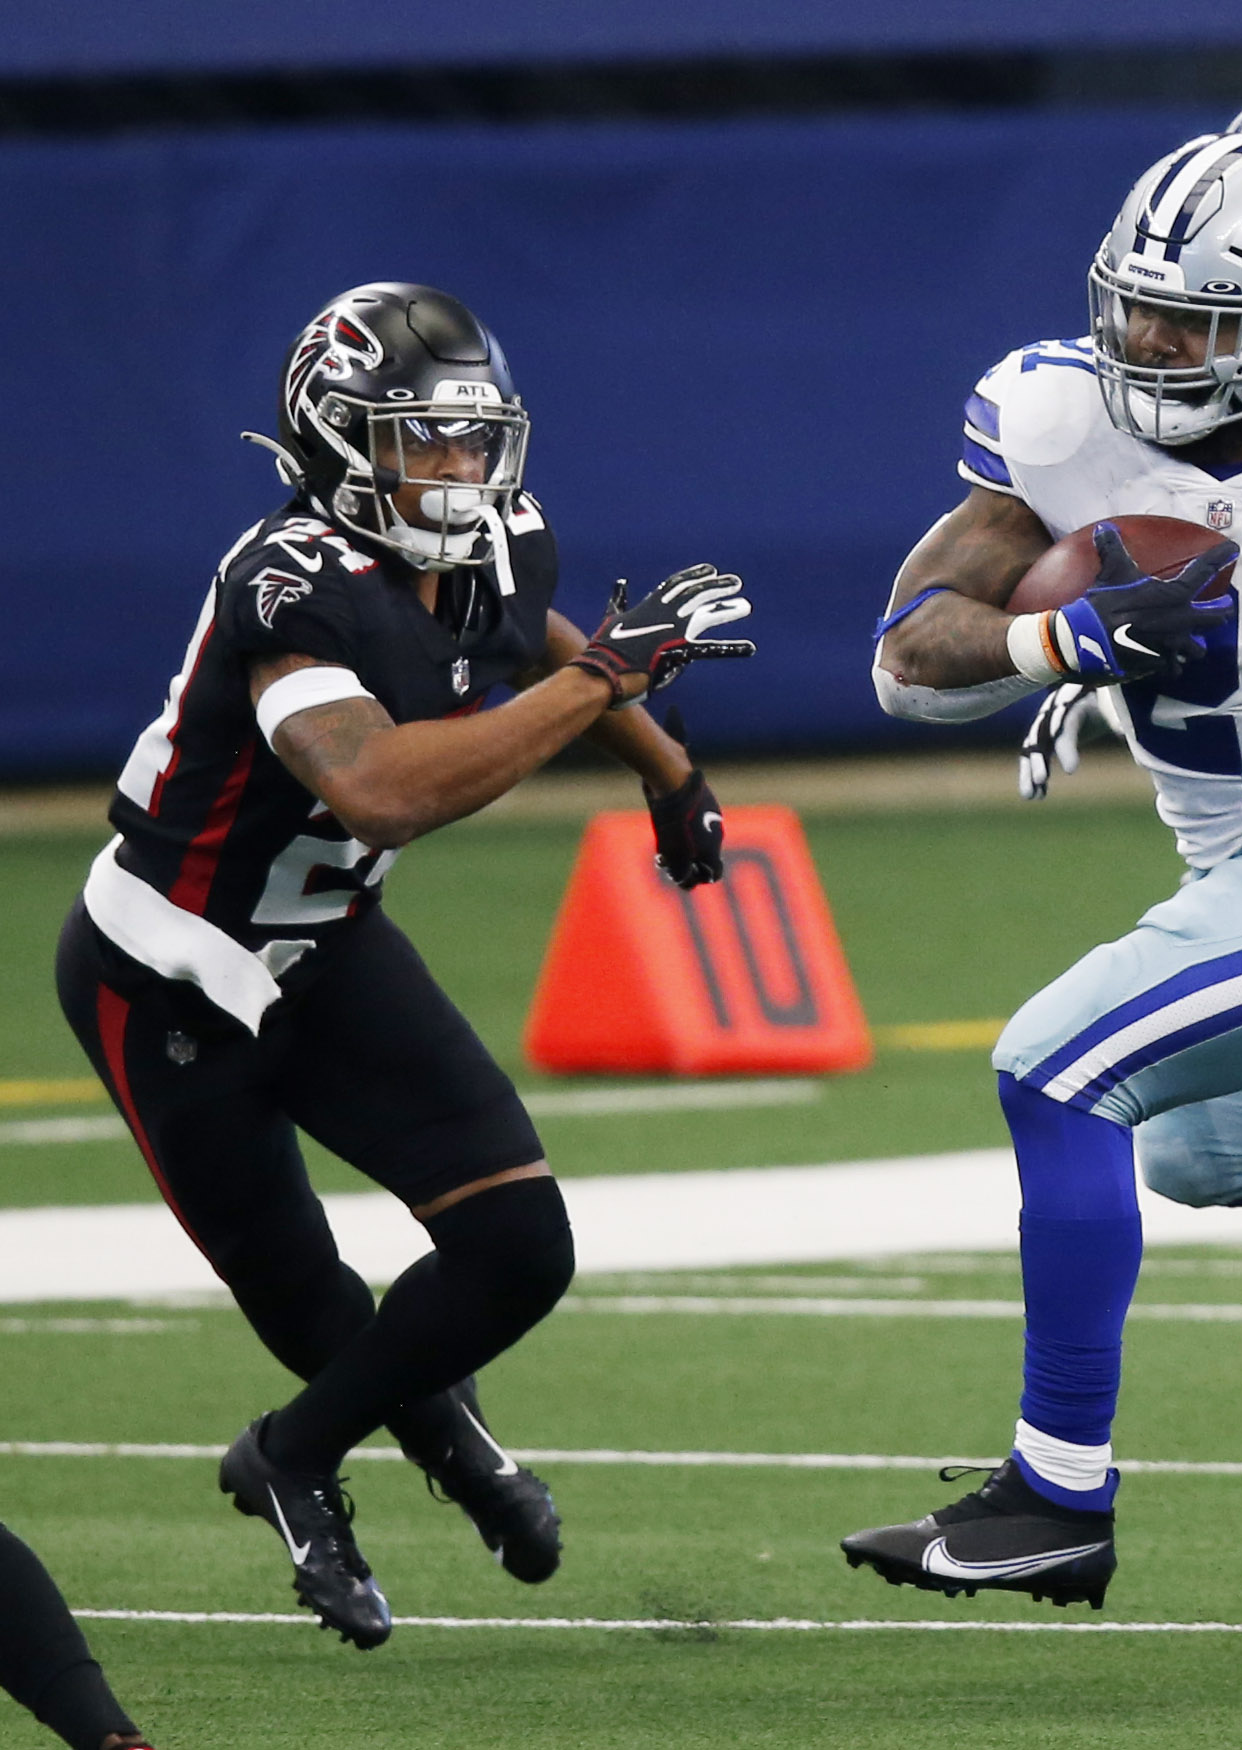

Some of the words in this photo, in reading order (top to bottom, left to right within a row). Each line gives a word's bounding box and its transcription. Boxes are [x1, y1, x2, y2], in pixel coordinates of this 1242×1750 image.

[1128, 264, 1166, 281] COWBOYS
[456, 385, 489, 398] ATL
[1209, 511, 1231, 527] NFL
[652, 848, 819, 1026] 10
